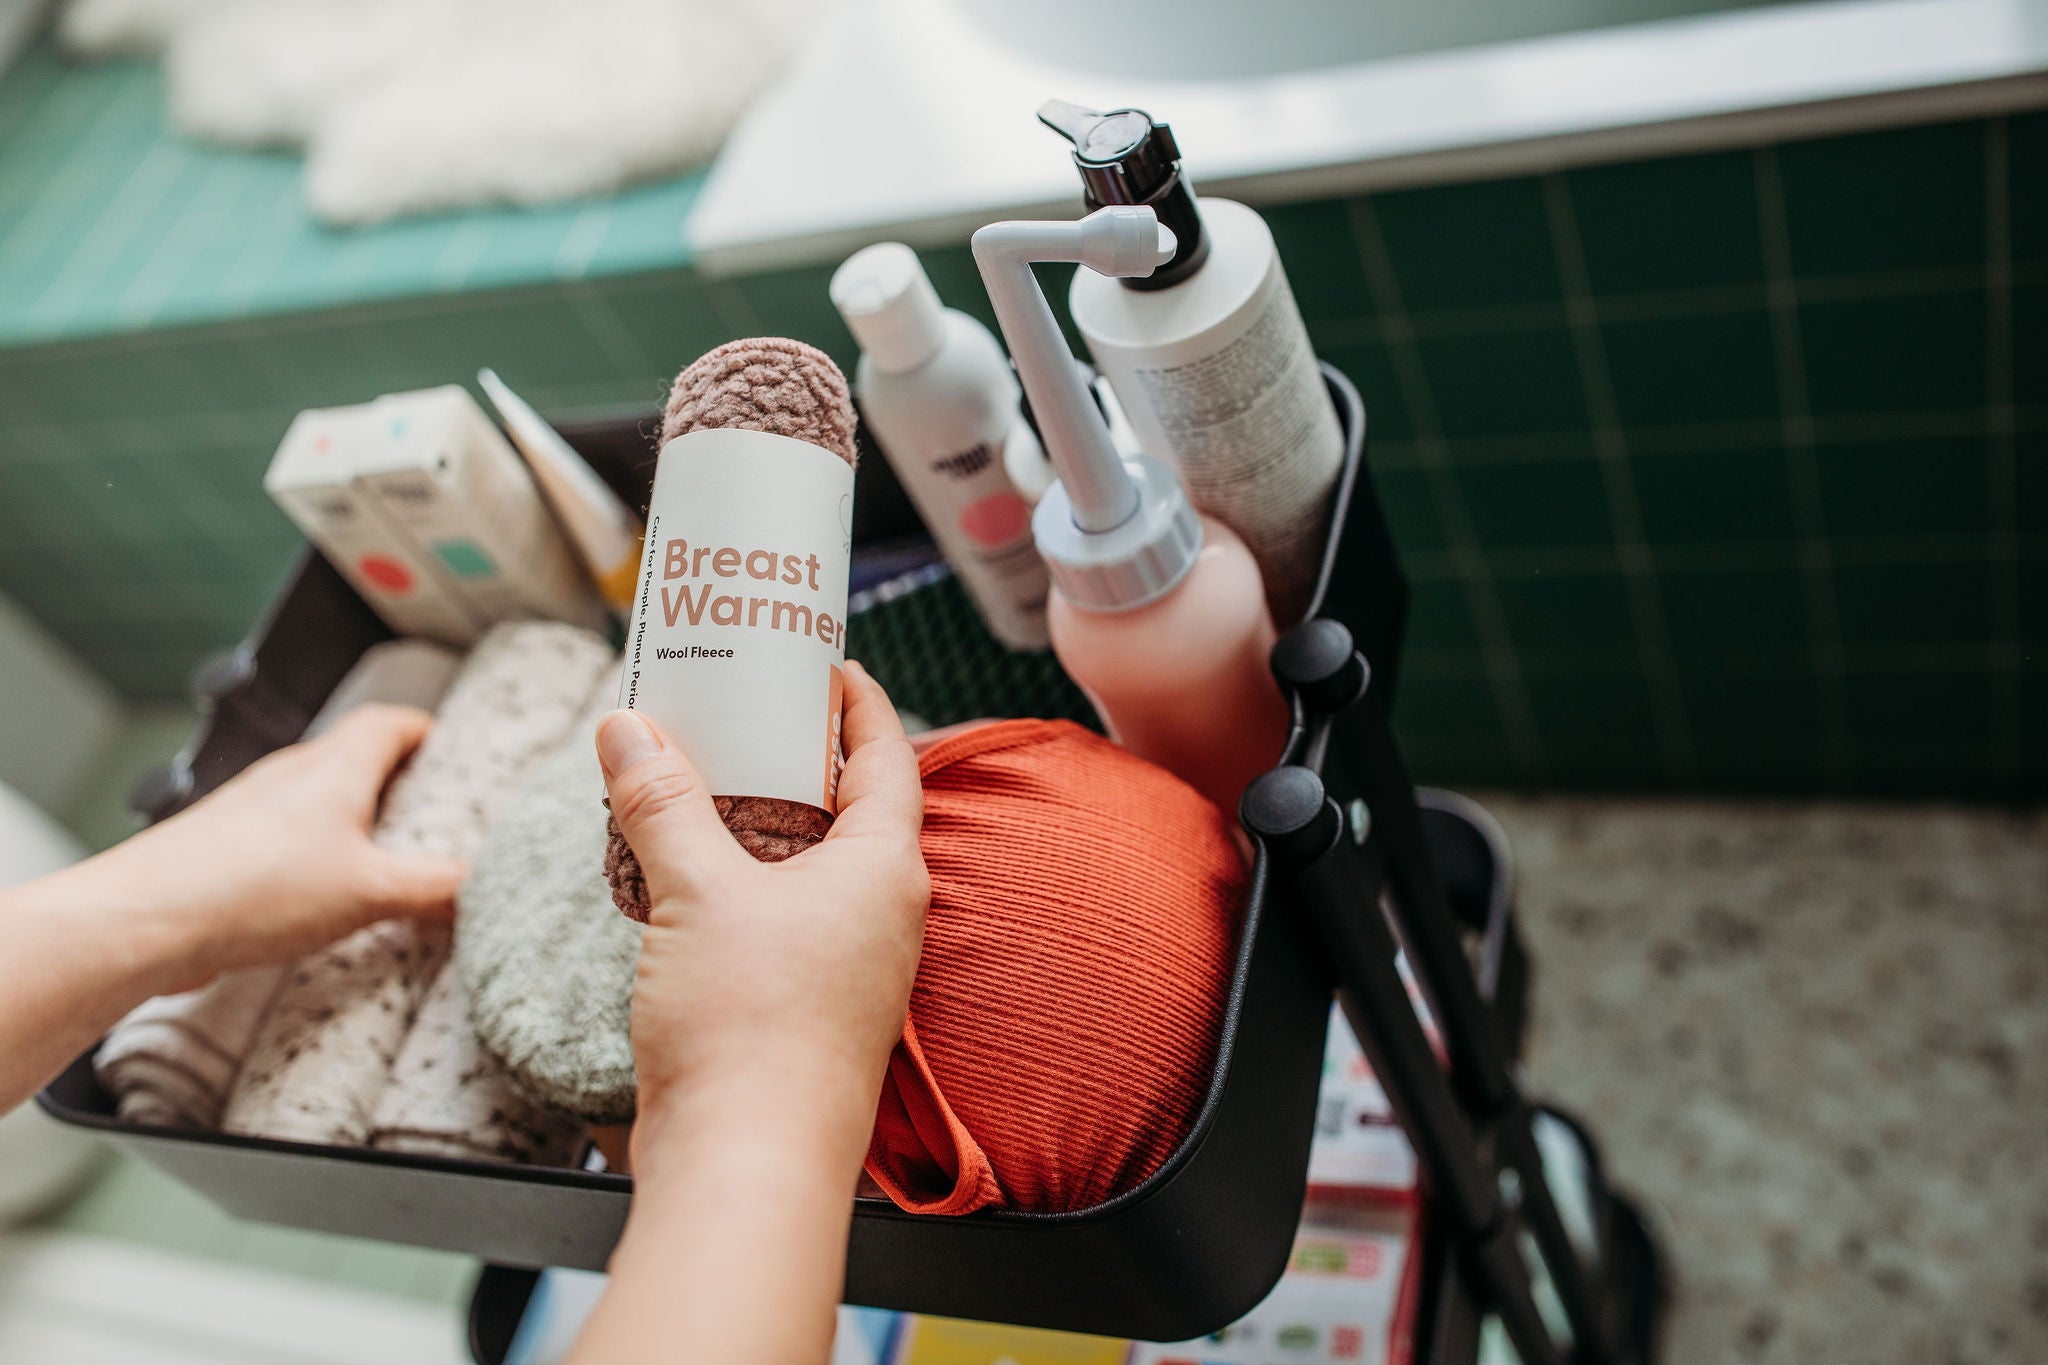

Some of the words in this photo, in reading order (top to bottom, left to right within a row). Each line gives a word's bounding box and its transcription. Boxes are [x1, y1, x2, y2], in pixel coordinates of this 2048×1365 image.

[651, 515, 660, 547] Care
[647, 549, 655, 568] for
[662, 538, 820, 592] Breast
[633, 621, 646, 668] Planet.
[656, 647, 688, 660] Wool
[691, 646, 734, 659] Fleece
